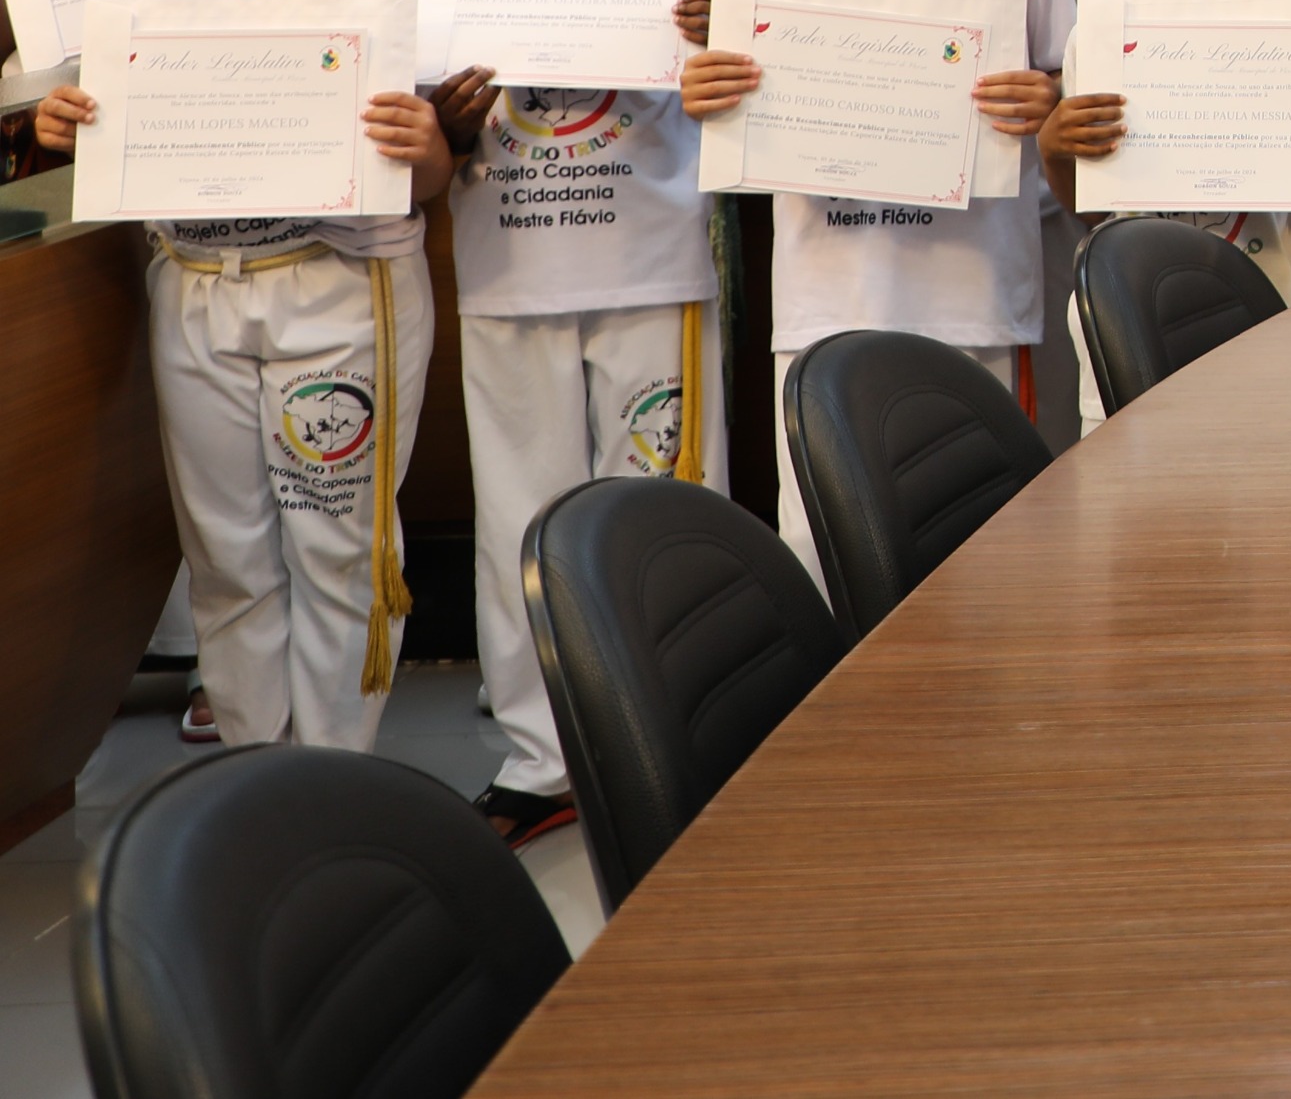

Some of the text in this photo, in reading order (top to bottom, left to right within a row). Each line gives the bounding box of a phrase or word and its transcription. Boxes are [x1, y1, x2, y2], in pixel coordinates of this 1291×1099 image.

[1144, 40, 1197, 61] Poder
[760, 91, 940, 120] JOÃO PEDRO CARDOSO RAMOS
[1145, 110, 1190, 121] MIGUEL
[1194, 110, 1209, 121] DE
[1213, 110, 1248, 121] PAULA
[140, 117, 309, 131] YASMIM LOPES MACEDO
[531, 145, 559, 161] DO
[565, 112, 633, 160] TRIUNFO
[485, 160, 632, 184] Projeto Capoeira
[501, 185, 614, 205] e Cidadania
[499, 207, 616, 229] Mestre Flávio
[826, 208, 933, 227] Mestre Flávio
[174, 220, 230, 242] Projeto
[268, 464, 371, 489] Projeto Capoeira
[304, 463, 325, 474] DO
[279, 484, 289, 493] e
[278, 498, 320, 512] Mestre
